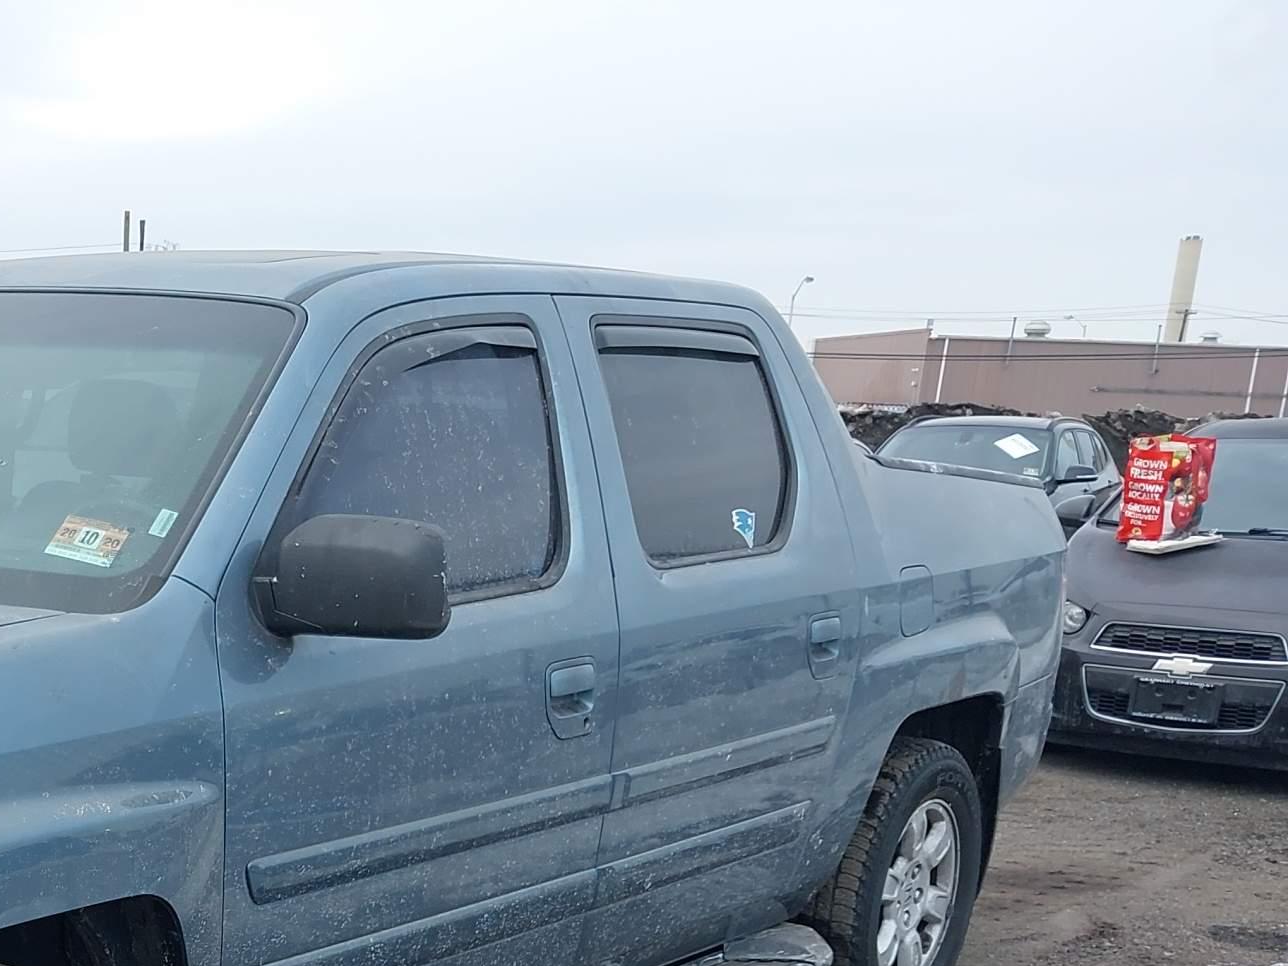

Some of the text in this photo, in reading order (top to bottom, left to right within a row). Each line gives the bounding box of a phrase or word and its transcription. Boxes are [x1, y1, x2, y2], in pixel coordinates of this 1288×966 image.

[1133, 457, 1168, 470] GROWN
[1128, 481, 1164, 493] GROWN
[1127, 502, 1161, 515] GROWN
[59, 527, 121, 549] 20 10 20
